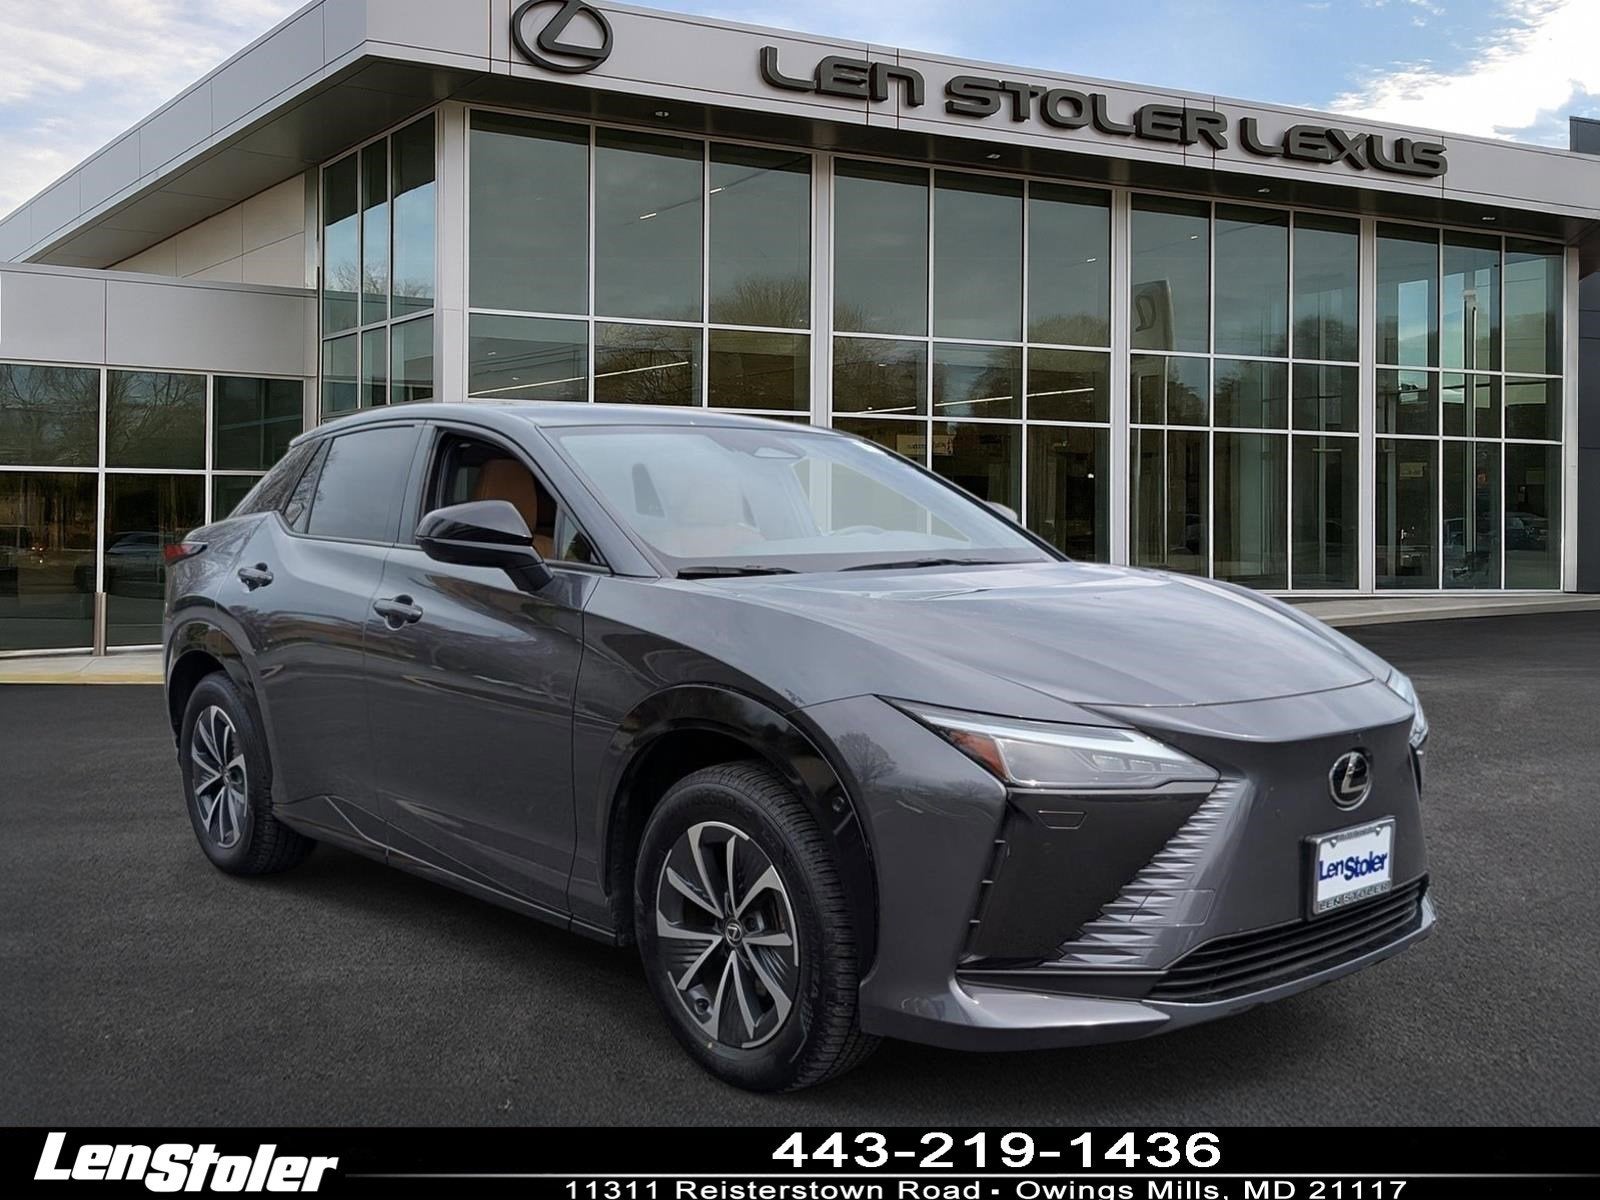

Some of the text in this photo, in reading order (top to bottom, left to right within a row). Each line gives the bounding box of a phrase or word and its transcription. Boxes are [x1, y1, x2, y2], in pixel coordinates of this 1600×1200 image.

[760, 45, 1448, 178] LEN STOLER LEXUS
